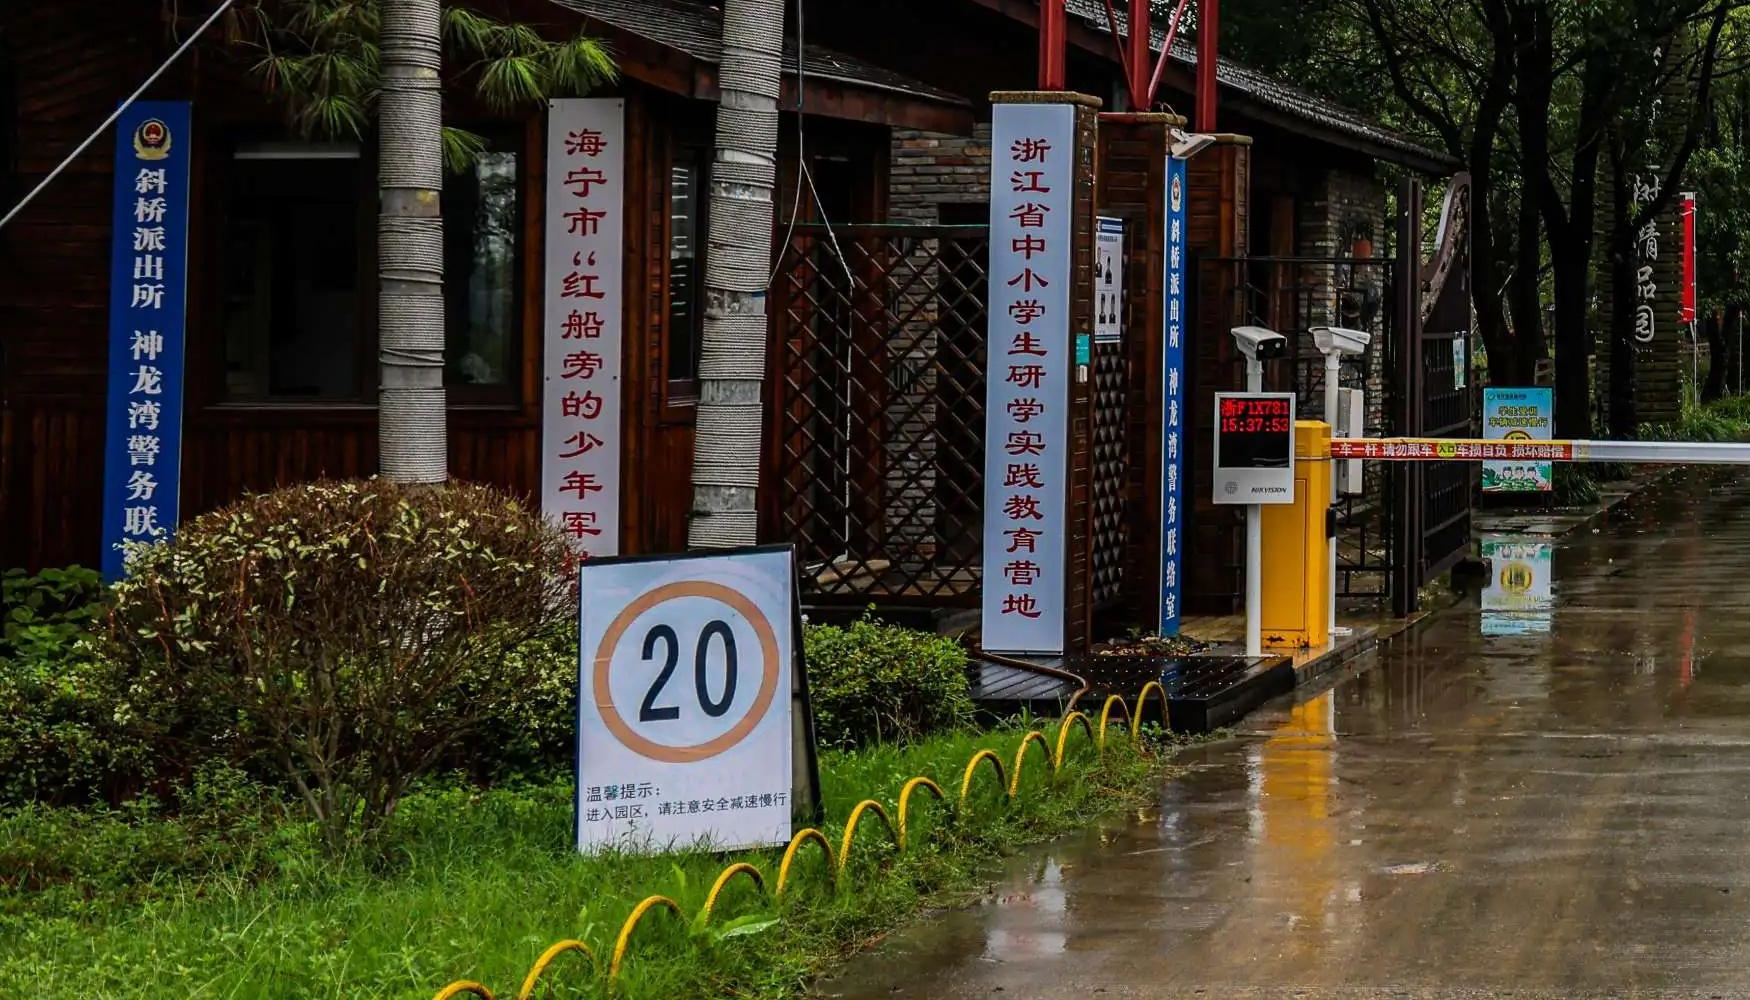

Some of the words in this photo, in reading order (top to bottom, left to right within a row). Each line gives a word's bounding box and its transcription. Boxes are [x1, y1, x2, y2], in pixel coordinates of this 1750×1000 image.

[131, 167, 168, 310] 斜桥派出所
[1169, 218, 1181, 348] 斜桥派出所
[559, 129, 607, 578] 海宁市“红船旁的少年军
[1002, 137, 1051, 619] 浙江省中小学生研学实践教育营地
[1221, 418, 1289, 432] 15:37:53
[1331, 443, 1378, 457] 一车一杆
[1382, 442, 1433, 457] 请勿跟车
[1456, 443, 1507, 457] 车损自负
[1512, 443, 1564, 457] 损坏赔偿
[1165, 368, 1179, 621] 神龙湾警务联络室
[639, 618, 738, 723] 20
[586, 781, 661, 803] 温馨提示：
